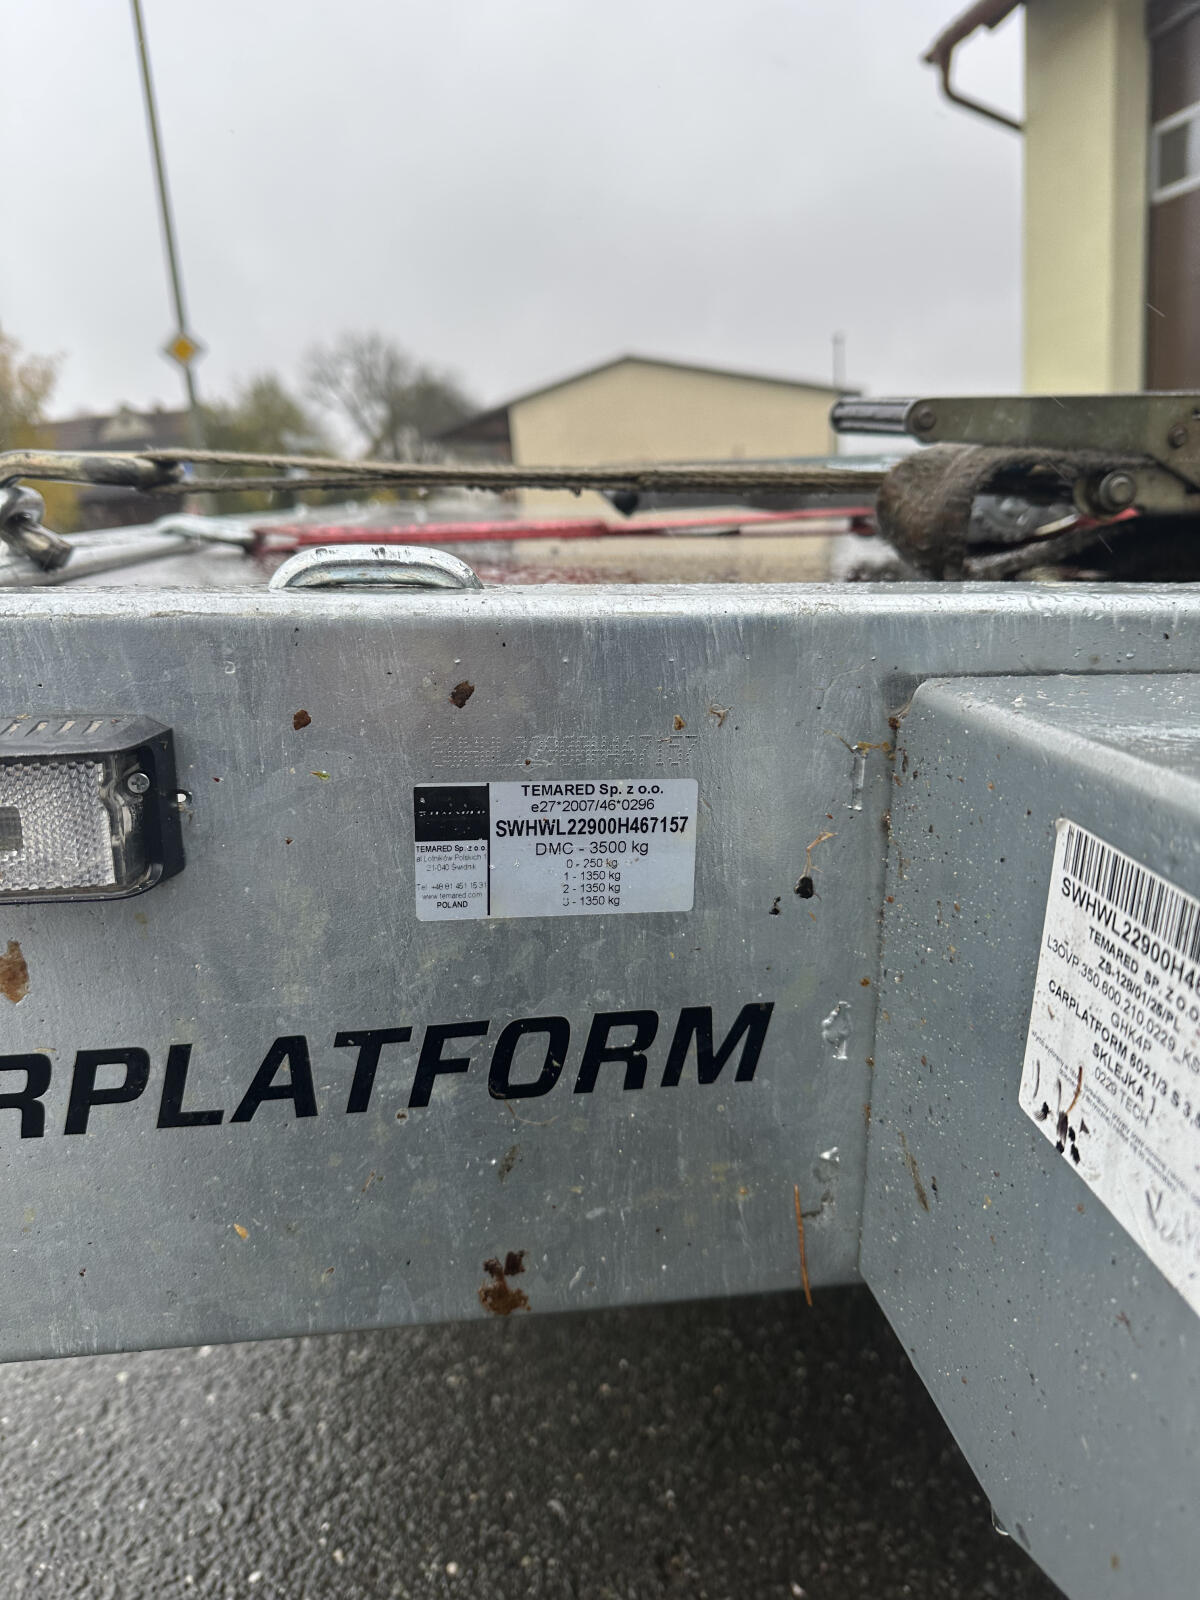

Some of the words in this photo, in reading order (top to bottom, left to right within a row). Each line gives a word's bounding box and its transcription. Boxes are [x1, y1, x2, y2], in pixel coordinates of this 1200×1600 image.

[521, 783, 596, 797] TEMARED
[599, 783, 622, 798] Sp.
[626, 785, 635, 795] z
[638, 784, 664, 795] o.o.
[495, 815, 689, 838] SWHWL22900H467157
[416, 845, 453, 853] TEMARED
[535, 842, 574, 856] DMC
[589, 840, 627, 854] 3500
[631, 840, 649, 856] kg
[566, 858, 574, 869] 0
[583, 858, 604, 869] 250
[605, 858, 618, 869] kg
[564, 871, 569, 881] 1
[580, 871, 606, 881] 1350
[608, 870, 621, 881] kg
[562, 884, 570, 893] 2
[580, 882, 606, 893] 1350
[608, 882, 621, 894] kg
[436, 900, 469, 909] POLAND
[580, 896, 606, 906] 1350
[608, 896, 620, 907] kg
[1089, 926, 1139, 975] TEMARED
[1165, 986, 1174, 1004] Z
[1110, 1011, 1152, 1053] GHK4P
[1048, 979, 1127, 1060] CARPLATFORM
[1170, 1090, 1180, 1108] S
[0, 1002, 775, 1139] RPLATFORM
[1092, 1042, 1145, 1103] SKLEJKA
[1094, 1066, 1118, 1097] 0229
[1118, 1088, 1149, 1129] TECH
